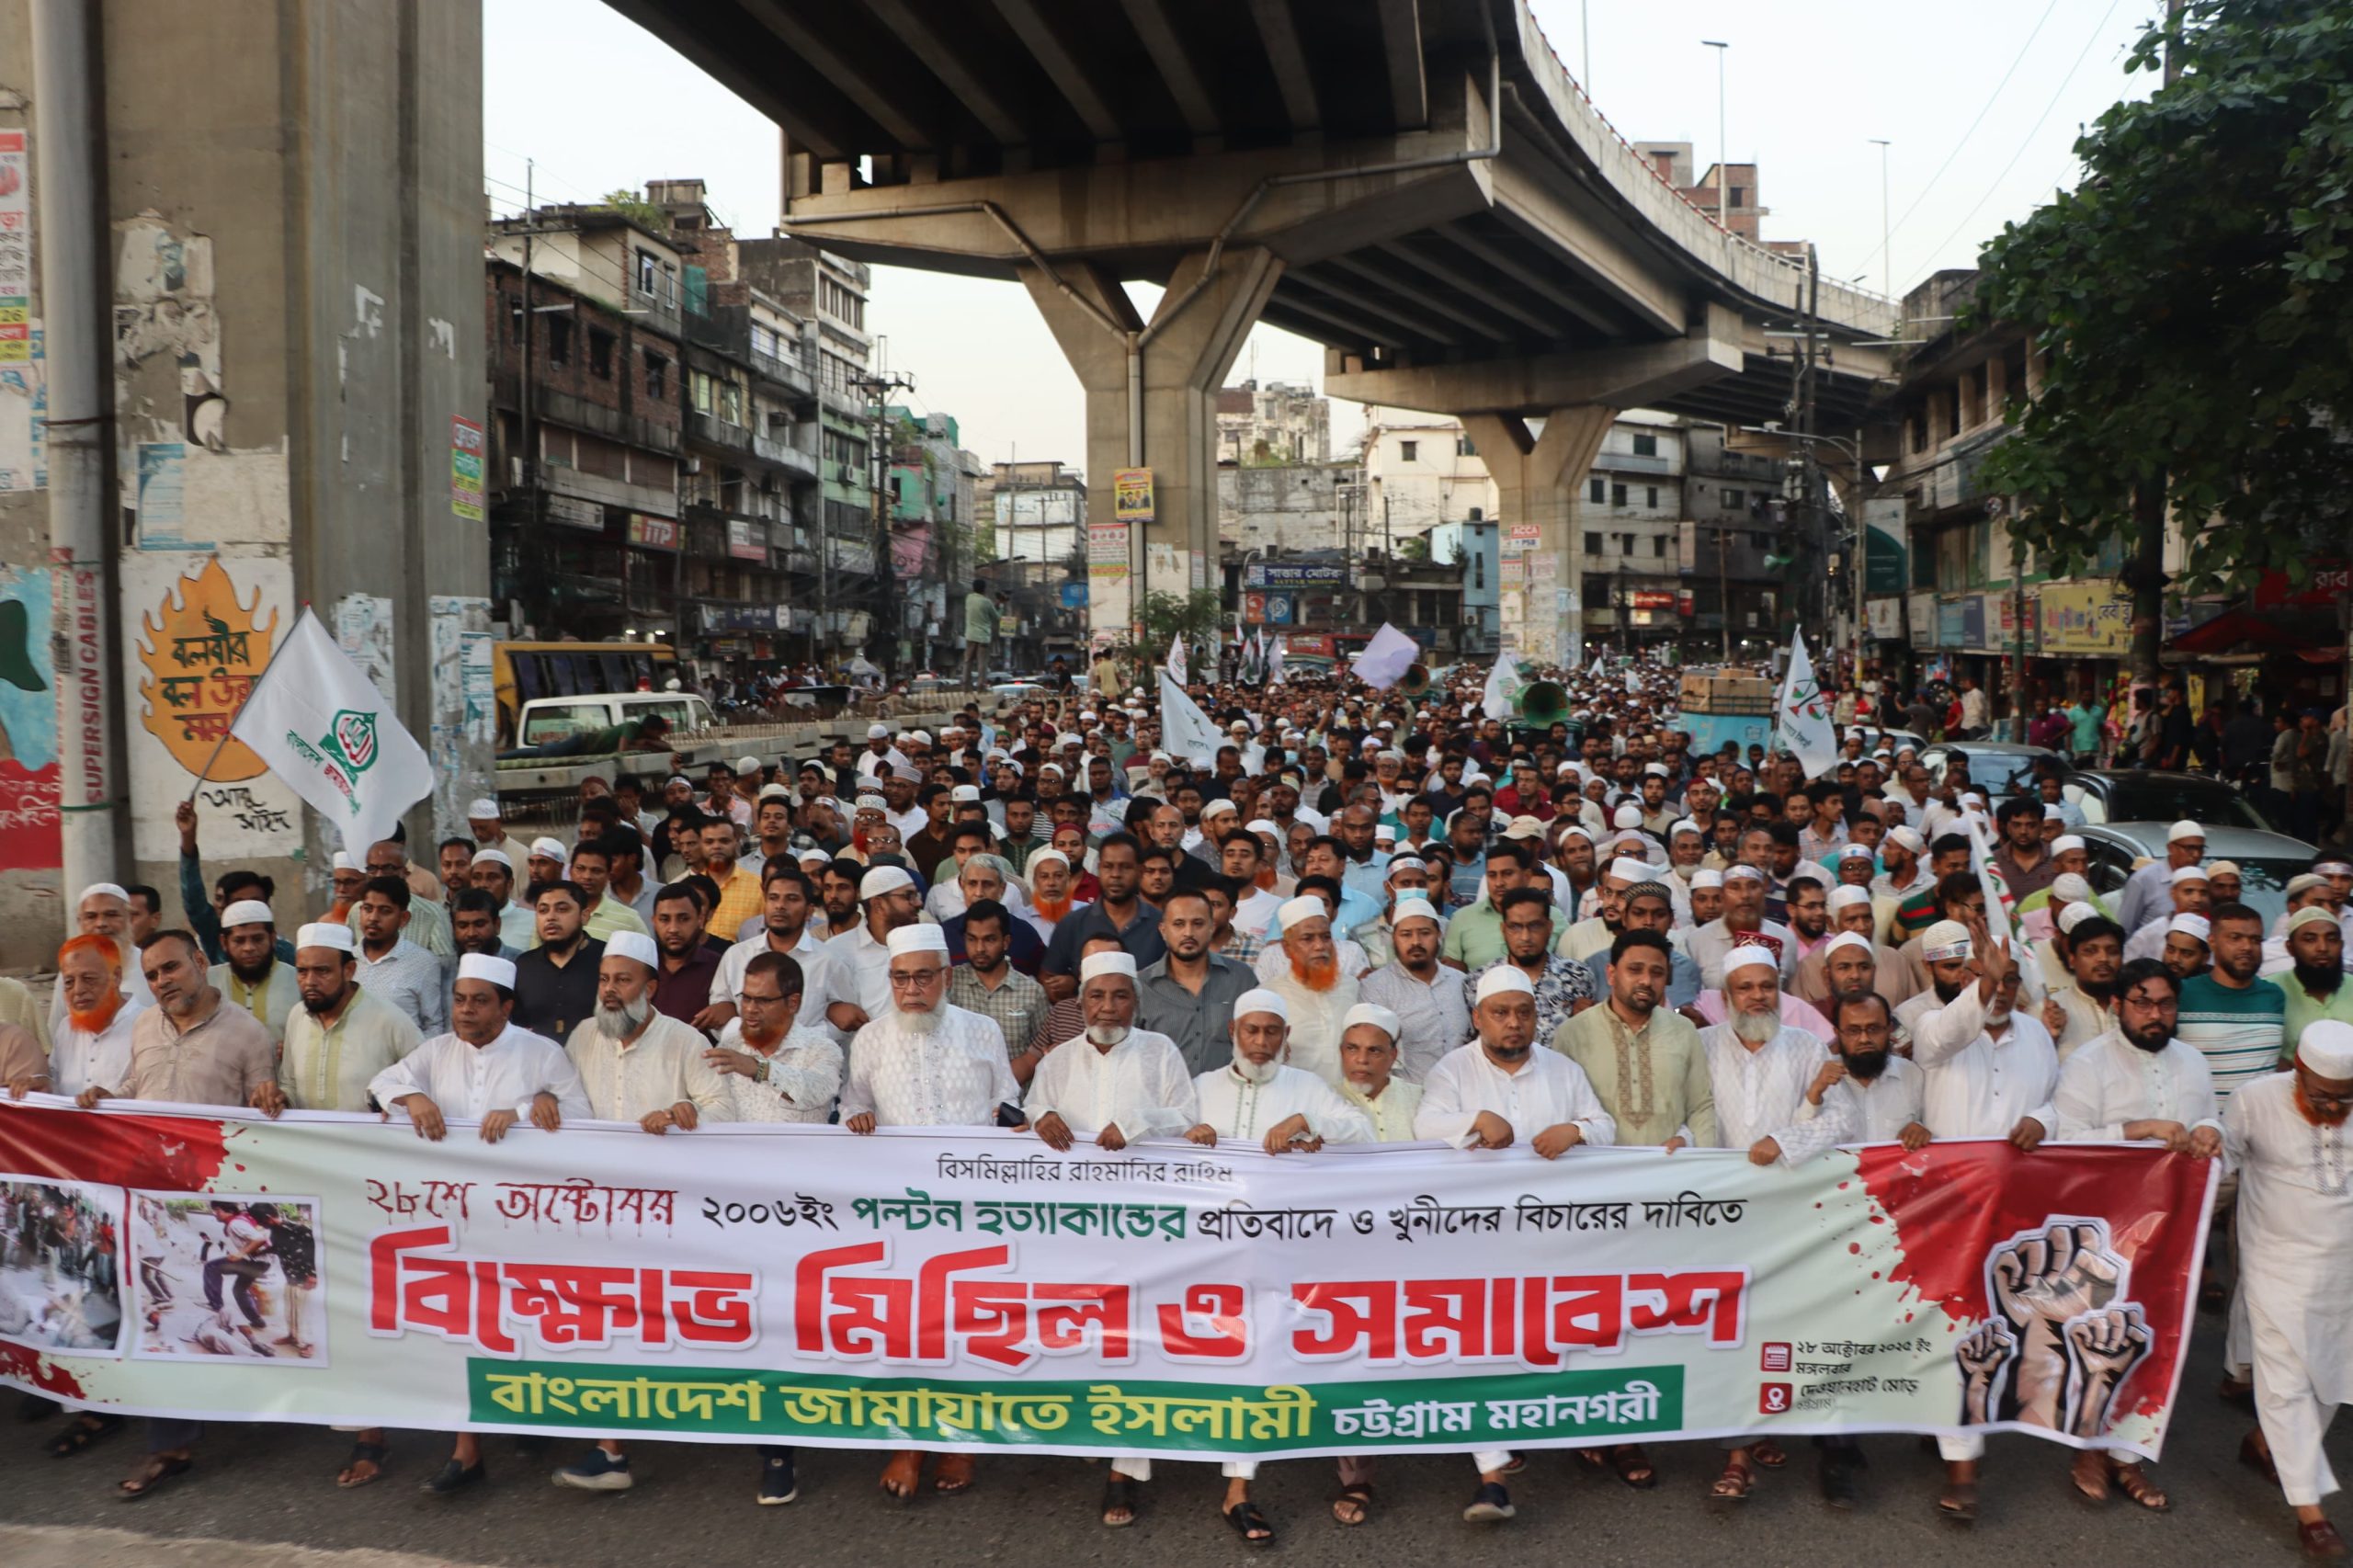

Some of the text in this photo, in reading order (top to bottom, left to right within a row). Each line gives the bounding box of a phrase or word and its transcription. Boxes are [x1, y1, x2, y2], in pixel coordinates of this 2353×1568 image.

[1514, 525, 1538, 536] ACCA
[1266, 567, 1302, 579] সাত্তার
[76, 571, 99, 665] CABLES
[160, 676, 204, 709] বল
[77, 667, 105, 803] SUPERSIGN
[938, 1153, 1063, 1184] বিসমিল্লাহির
[1069, 1157, 1167, 1183] রাহমানির
[366, 1178, 477, 1227] ২৮শে
[494, 1178, 679, 1234] অক্টোবর
[851, 1187, 963, 1233] পল্টন
[974, 1200, 1187, 1243] হত্যাকান্ডের
[1197, 1199, 1337, 1243] প্রতিবাদে
[1348, 1210, 1375, 1236] ও
[1388, 1195, 1506, 1243] খুনীদের
[1515, 1193, 1631, 1233] বিচারের
[1641, 1190, 1748, 1230] দাবিতে
[369, 1224, 1745, 1367] বিক্ষোভ মিছিল ও সমাবেশ
[1796, 1340, 1818, 1355] ২৮
[1821, 1340, 1876, 1359] অক্টোবর
[1878, 1340, 1913, 1354] ২০২৫
[1795, 1361, 1853, 1376] মঙ্গলবার
[485, 1371, 1663, 1440] বাংলাদেশ জামায়াতে ইসলামী চট্টগ্রাম মহানগরী
